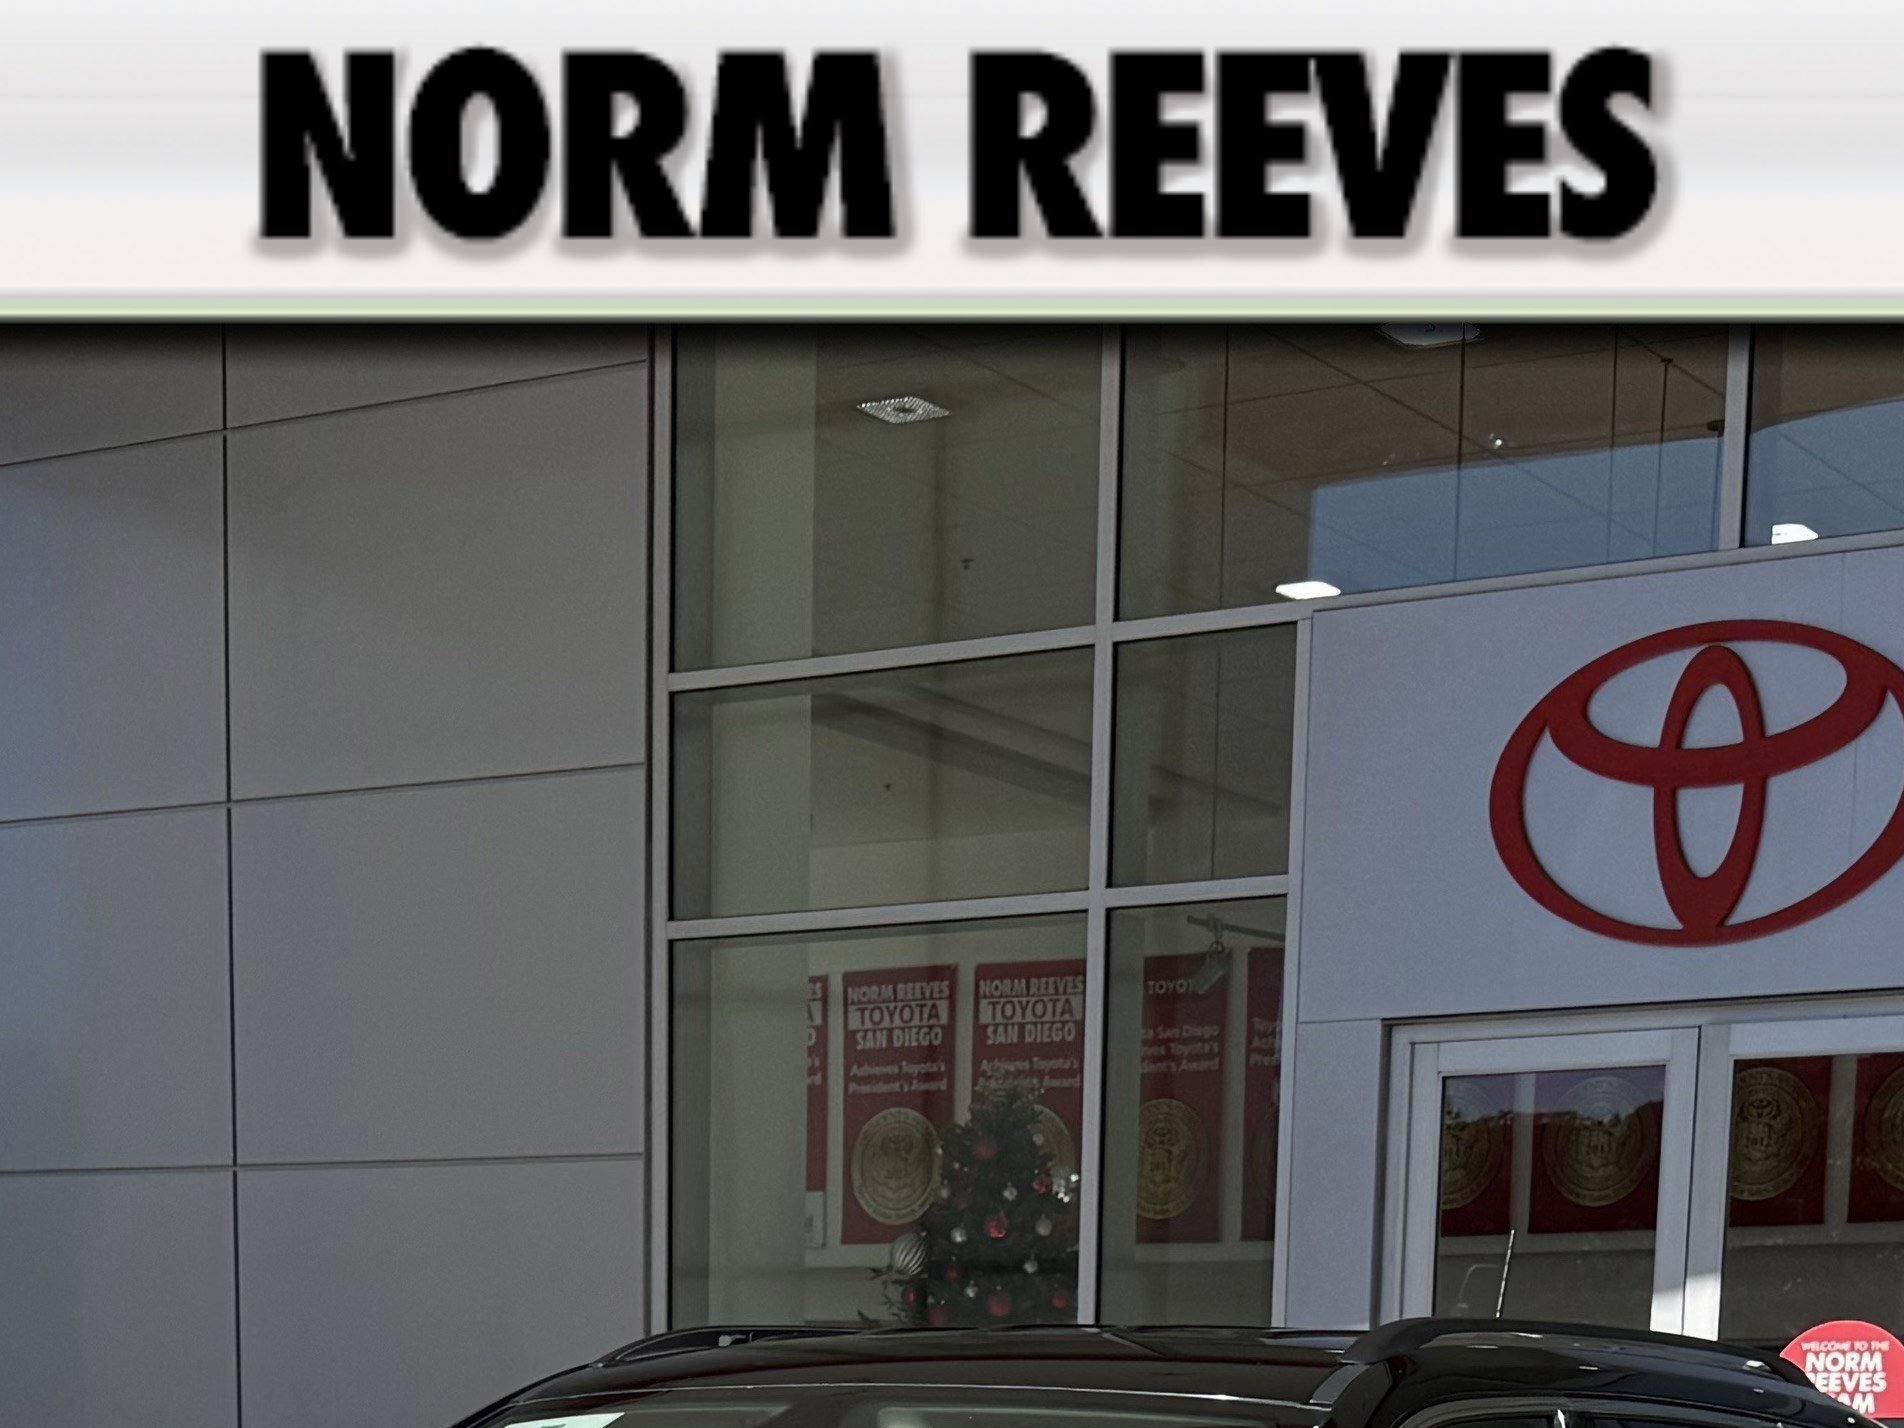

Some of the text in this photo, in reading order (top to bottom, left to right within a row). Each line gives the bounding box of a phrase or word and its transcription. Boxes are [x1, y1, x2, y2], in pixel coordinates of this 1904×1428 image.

[848, 981, 949, 1003] NORM REEVES
[979, 976, 1083, 998] NORM REEVES
[1146, 979, 1193, 994] TOYOT
[857, 1003, 940, 1026] TOYOTA
[989, 998, 1074, 1021] TOYOTA
[856, 1027, 943, 1049] SAN DIEGO
[986, 1022, 1076, 1045] SAN DIEGO
[1801, 1340, 1891, 1352] WELCOME TO THE
[1805, 1351, 1883, 1372] NORM
